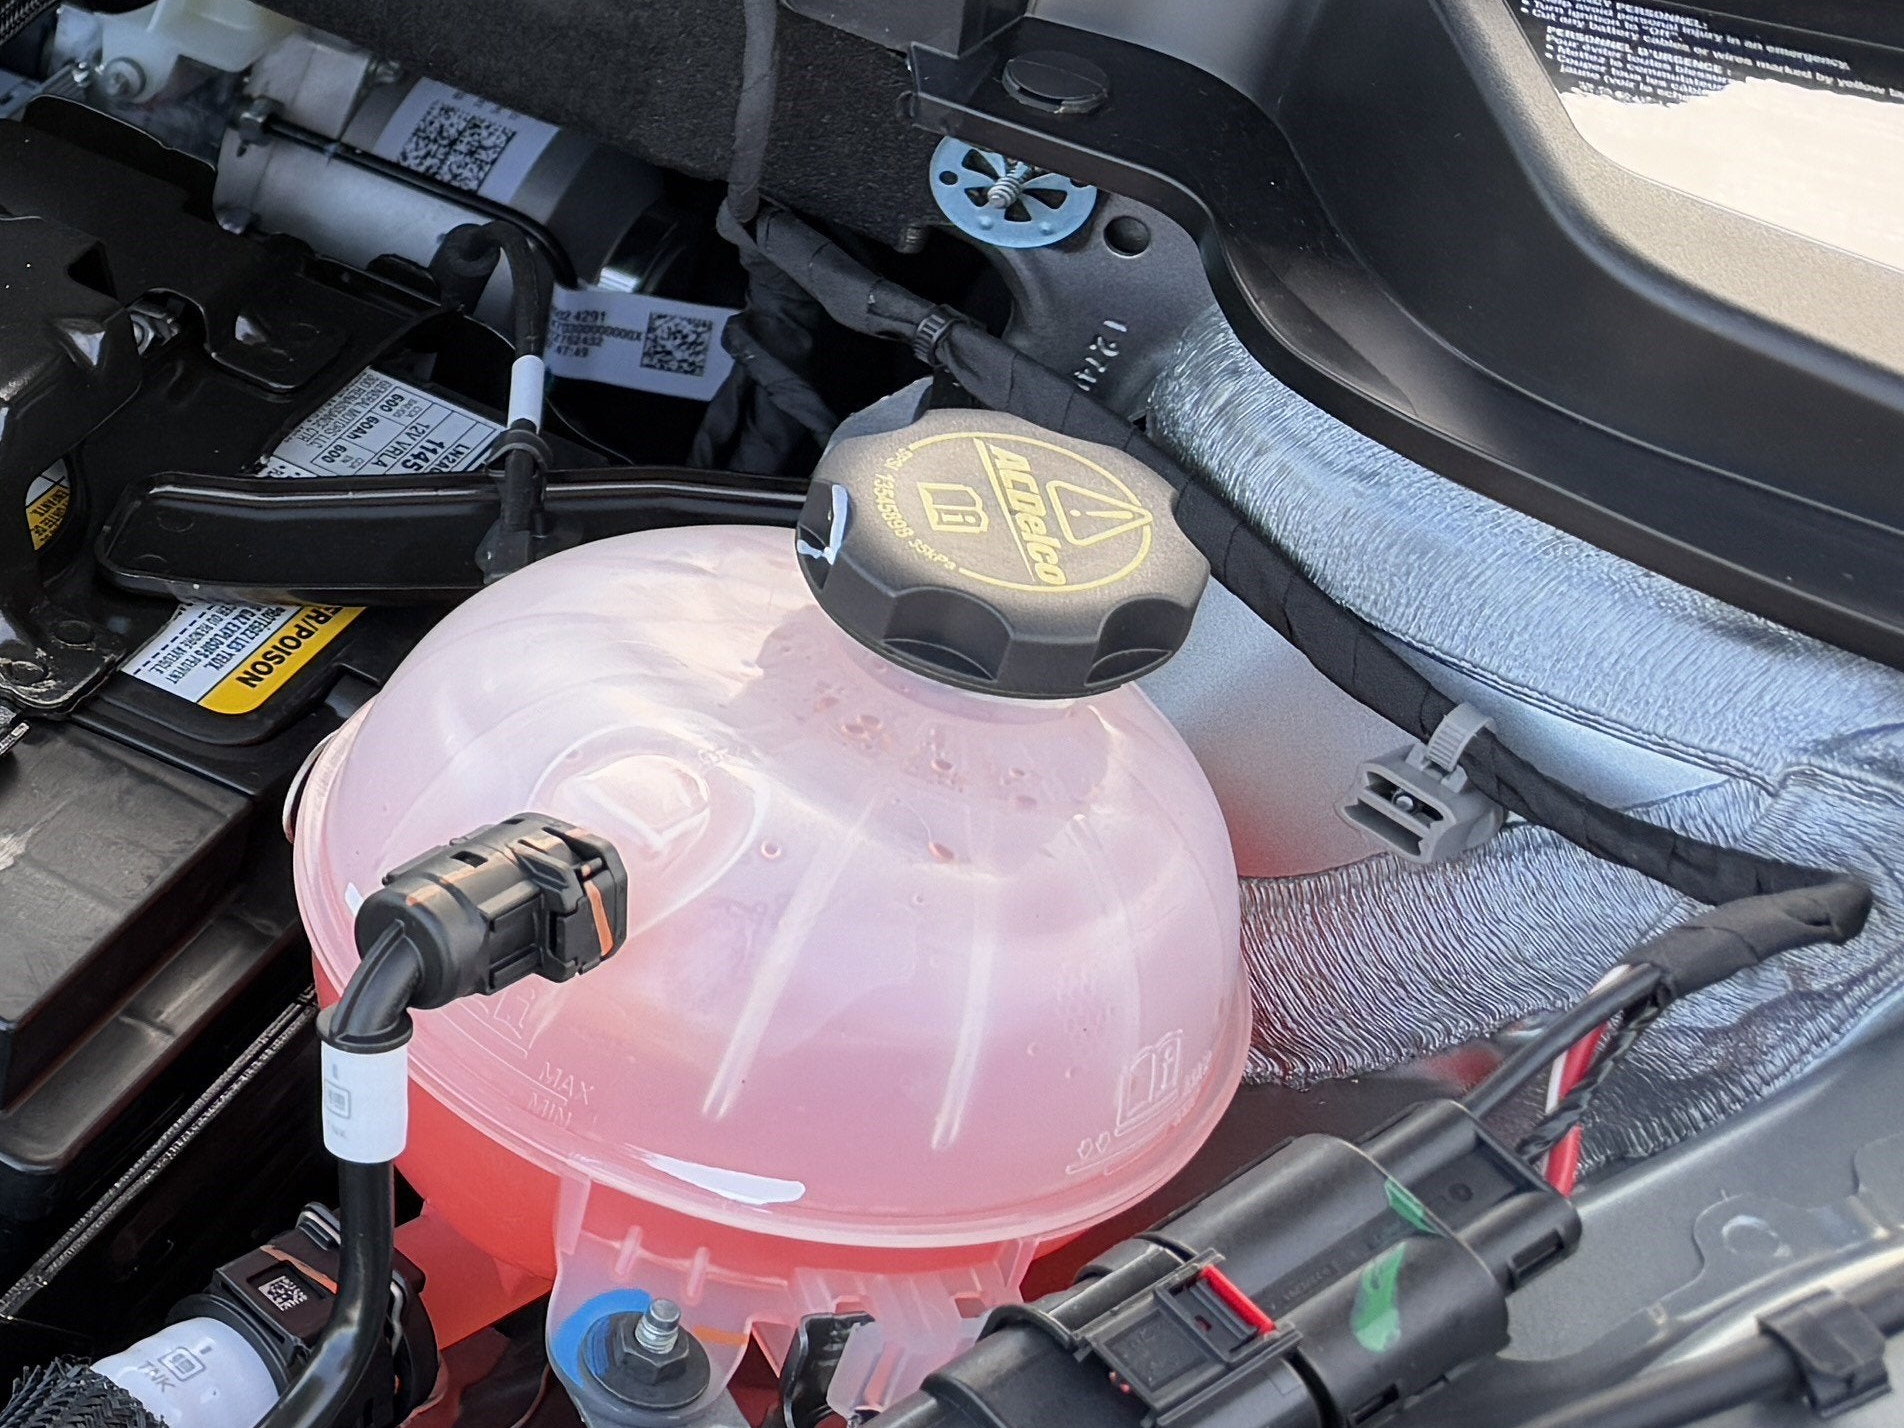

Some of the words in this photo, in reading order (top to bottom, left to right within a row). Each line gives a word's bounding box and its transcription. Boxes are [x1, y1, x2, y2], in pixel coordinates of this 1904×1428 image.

[1615, 1, 1707, 30] PERSONNEL:
[1546, 25, 1632, 53] PERSONNEL
[342, 414, 382, 441] 60Ah
[400, 420, 433, 441] 12V
[367, 438, 414, 469] VRLA
[394, 436, 451, 472] 1145
[989, 443, 1068, 586] ACDelco
[539, 1061, 594, 1106] MAX
[528, 1092, 572, 1128] MIN
